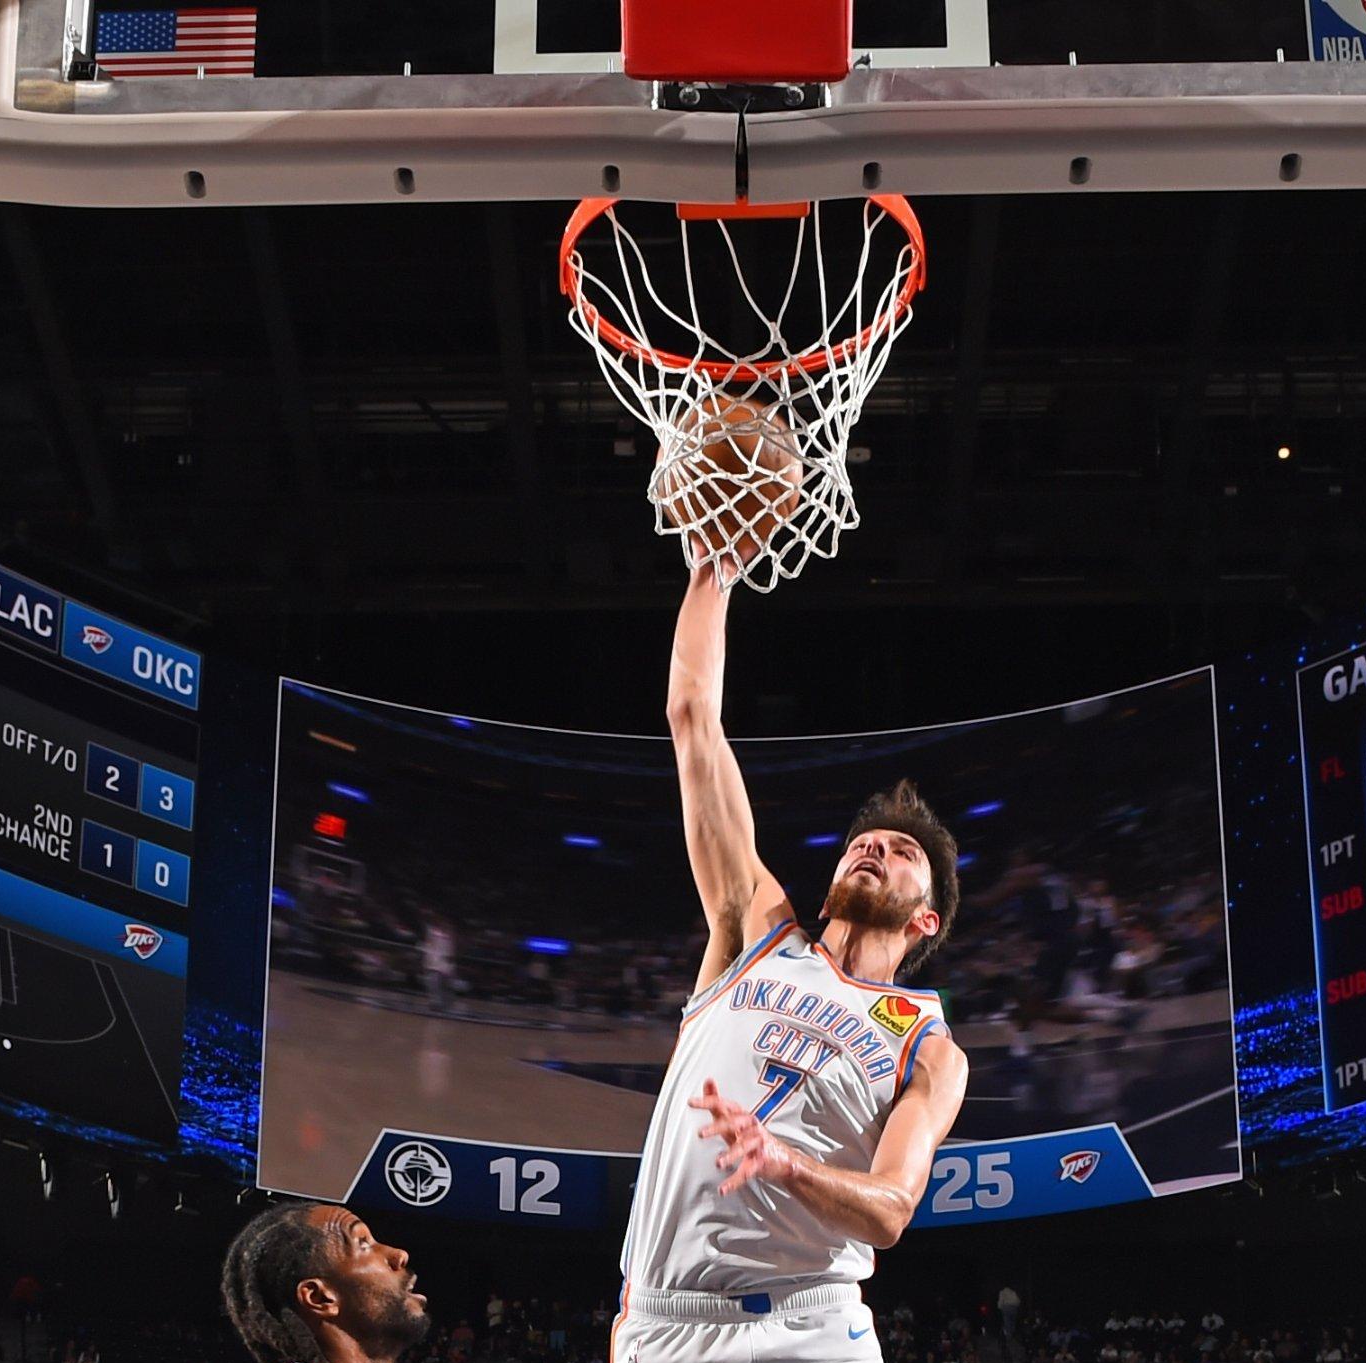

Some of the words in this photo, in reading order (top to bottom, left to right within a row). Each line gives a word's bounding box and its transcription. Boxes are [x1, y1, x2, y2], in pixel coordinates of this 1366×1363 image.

[1322, 37, 1365, 61] NBA
[132, 645, 194, 697] OKC
[2, 722, 36, 755] OFF
[42, 735, 77, 773] T/O
[105, 766, 120, 791] 2
[159, 785, 174, 811] 3
[34, 802, 72, 838] 2ND
[154, 860, 169, 888] 0
[1320, 834, 1356, 867] 1PT
[1321, 886, 1363, 920] SUB
[729, 979, 898, 1084] OKLAHOMA
[754, 1020, 842, 1075] CITY
[750, 1059, 807, 1125] 7
[489, 1155, 560, 1215] 12
[931, 1151, 1014, 1213] 25
